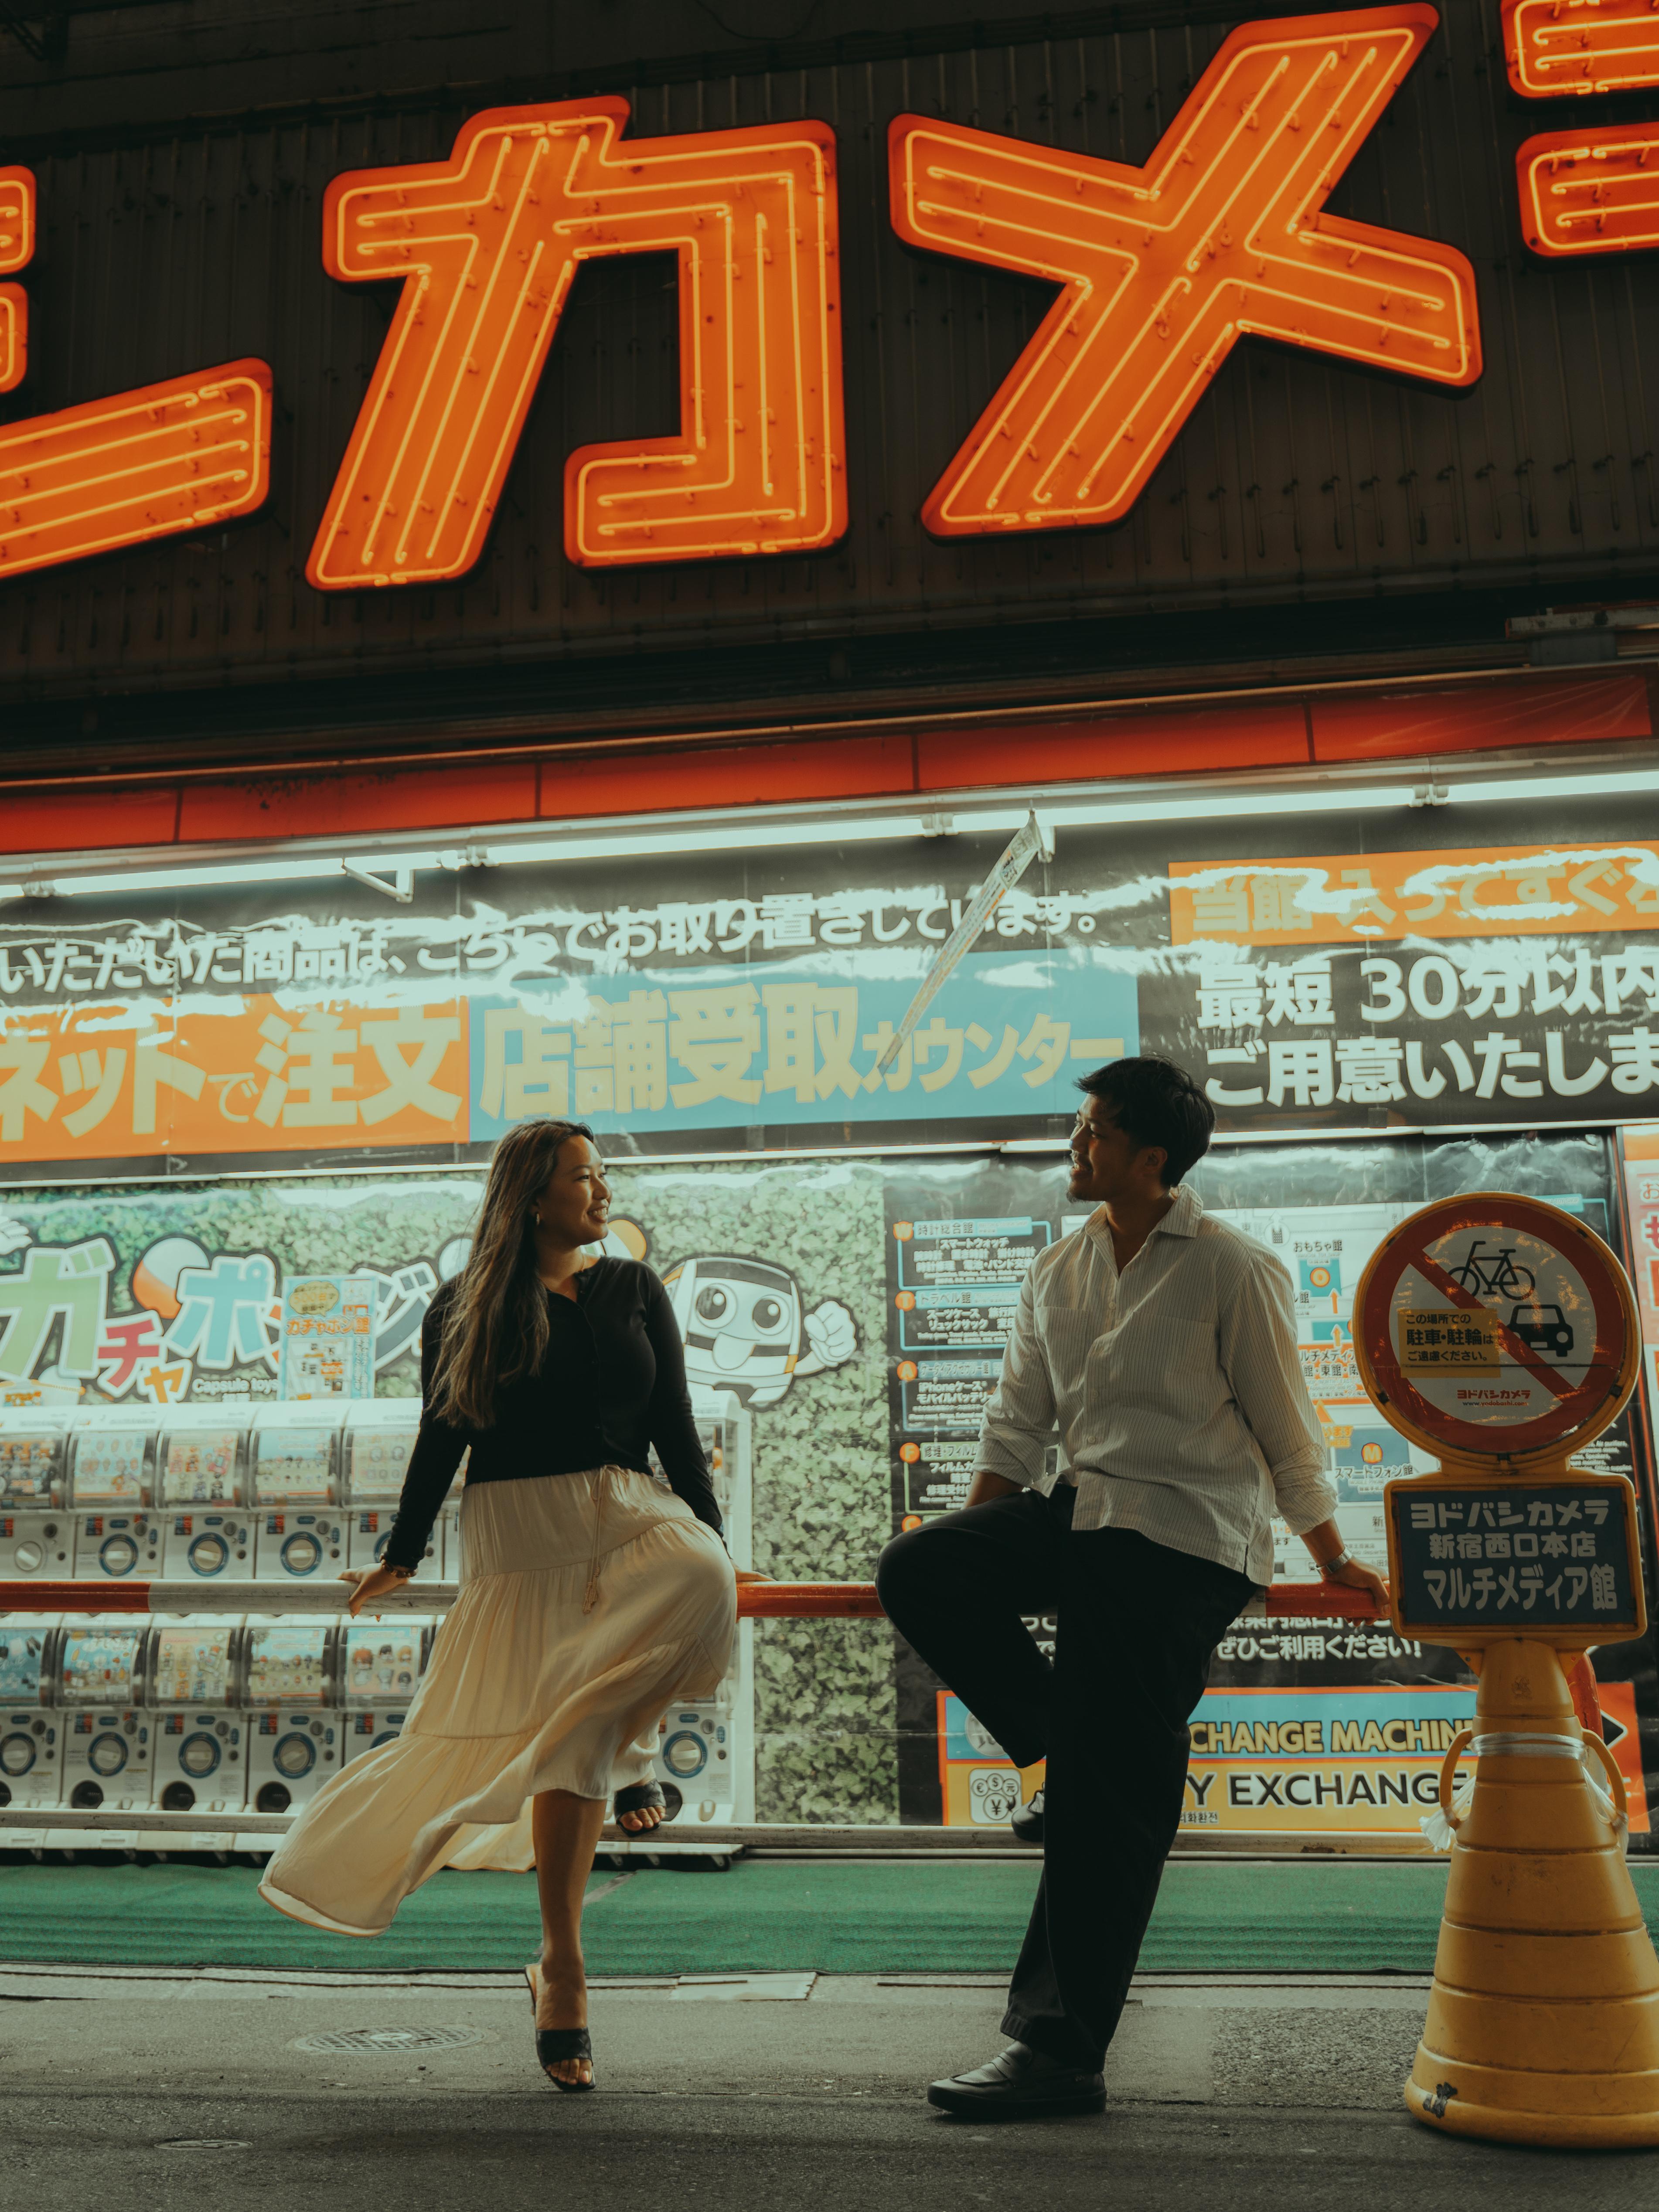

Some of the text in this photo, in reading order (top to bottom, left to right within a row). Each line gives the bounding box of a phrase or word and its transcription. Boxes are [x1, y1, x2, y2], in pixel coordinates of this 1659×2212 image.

[1195, 959, 1336, 1029] 最短
[0, 982, 1124, 1141] ネットで注文 店舗受取カウンター
[1205, 1026, 1659, 1106] ご用意いたしま
[1294, 1239, 1342, 1252] おもちゃ館
[921, 1292, 971, 1304] トラベル館
[926, 1308, 981, 1320] スーツケース
[1406, 1314, 1471, 1324] この場所での
[927, 1318, 989, 1331] リュックサック
[1407, 1328, 1493, 1345] 駐車・駐輪は
[1408, 1350, 1487, 1361] ご遠慮ください。
[192, 1377, 278, 1396] Capsule toys
[1457, 1390, 1531, 1399] ヨドバシカメラ
[1334, 1463, 1414, 1479] スマートフォン館
[1410, 1499, 1609, 1528] ヨドバシカメラ
[1429, 1531, 1597, 1559] 新宿西口本店
[1423, 1562, 1618, 1611] マルチメディア館
